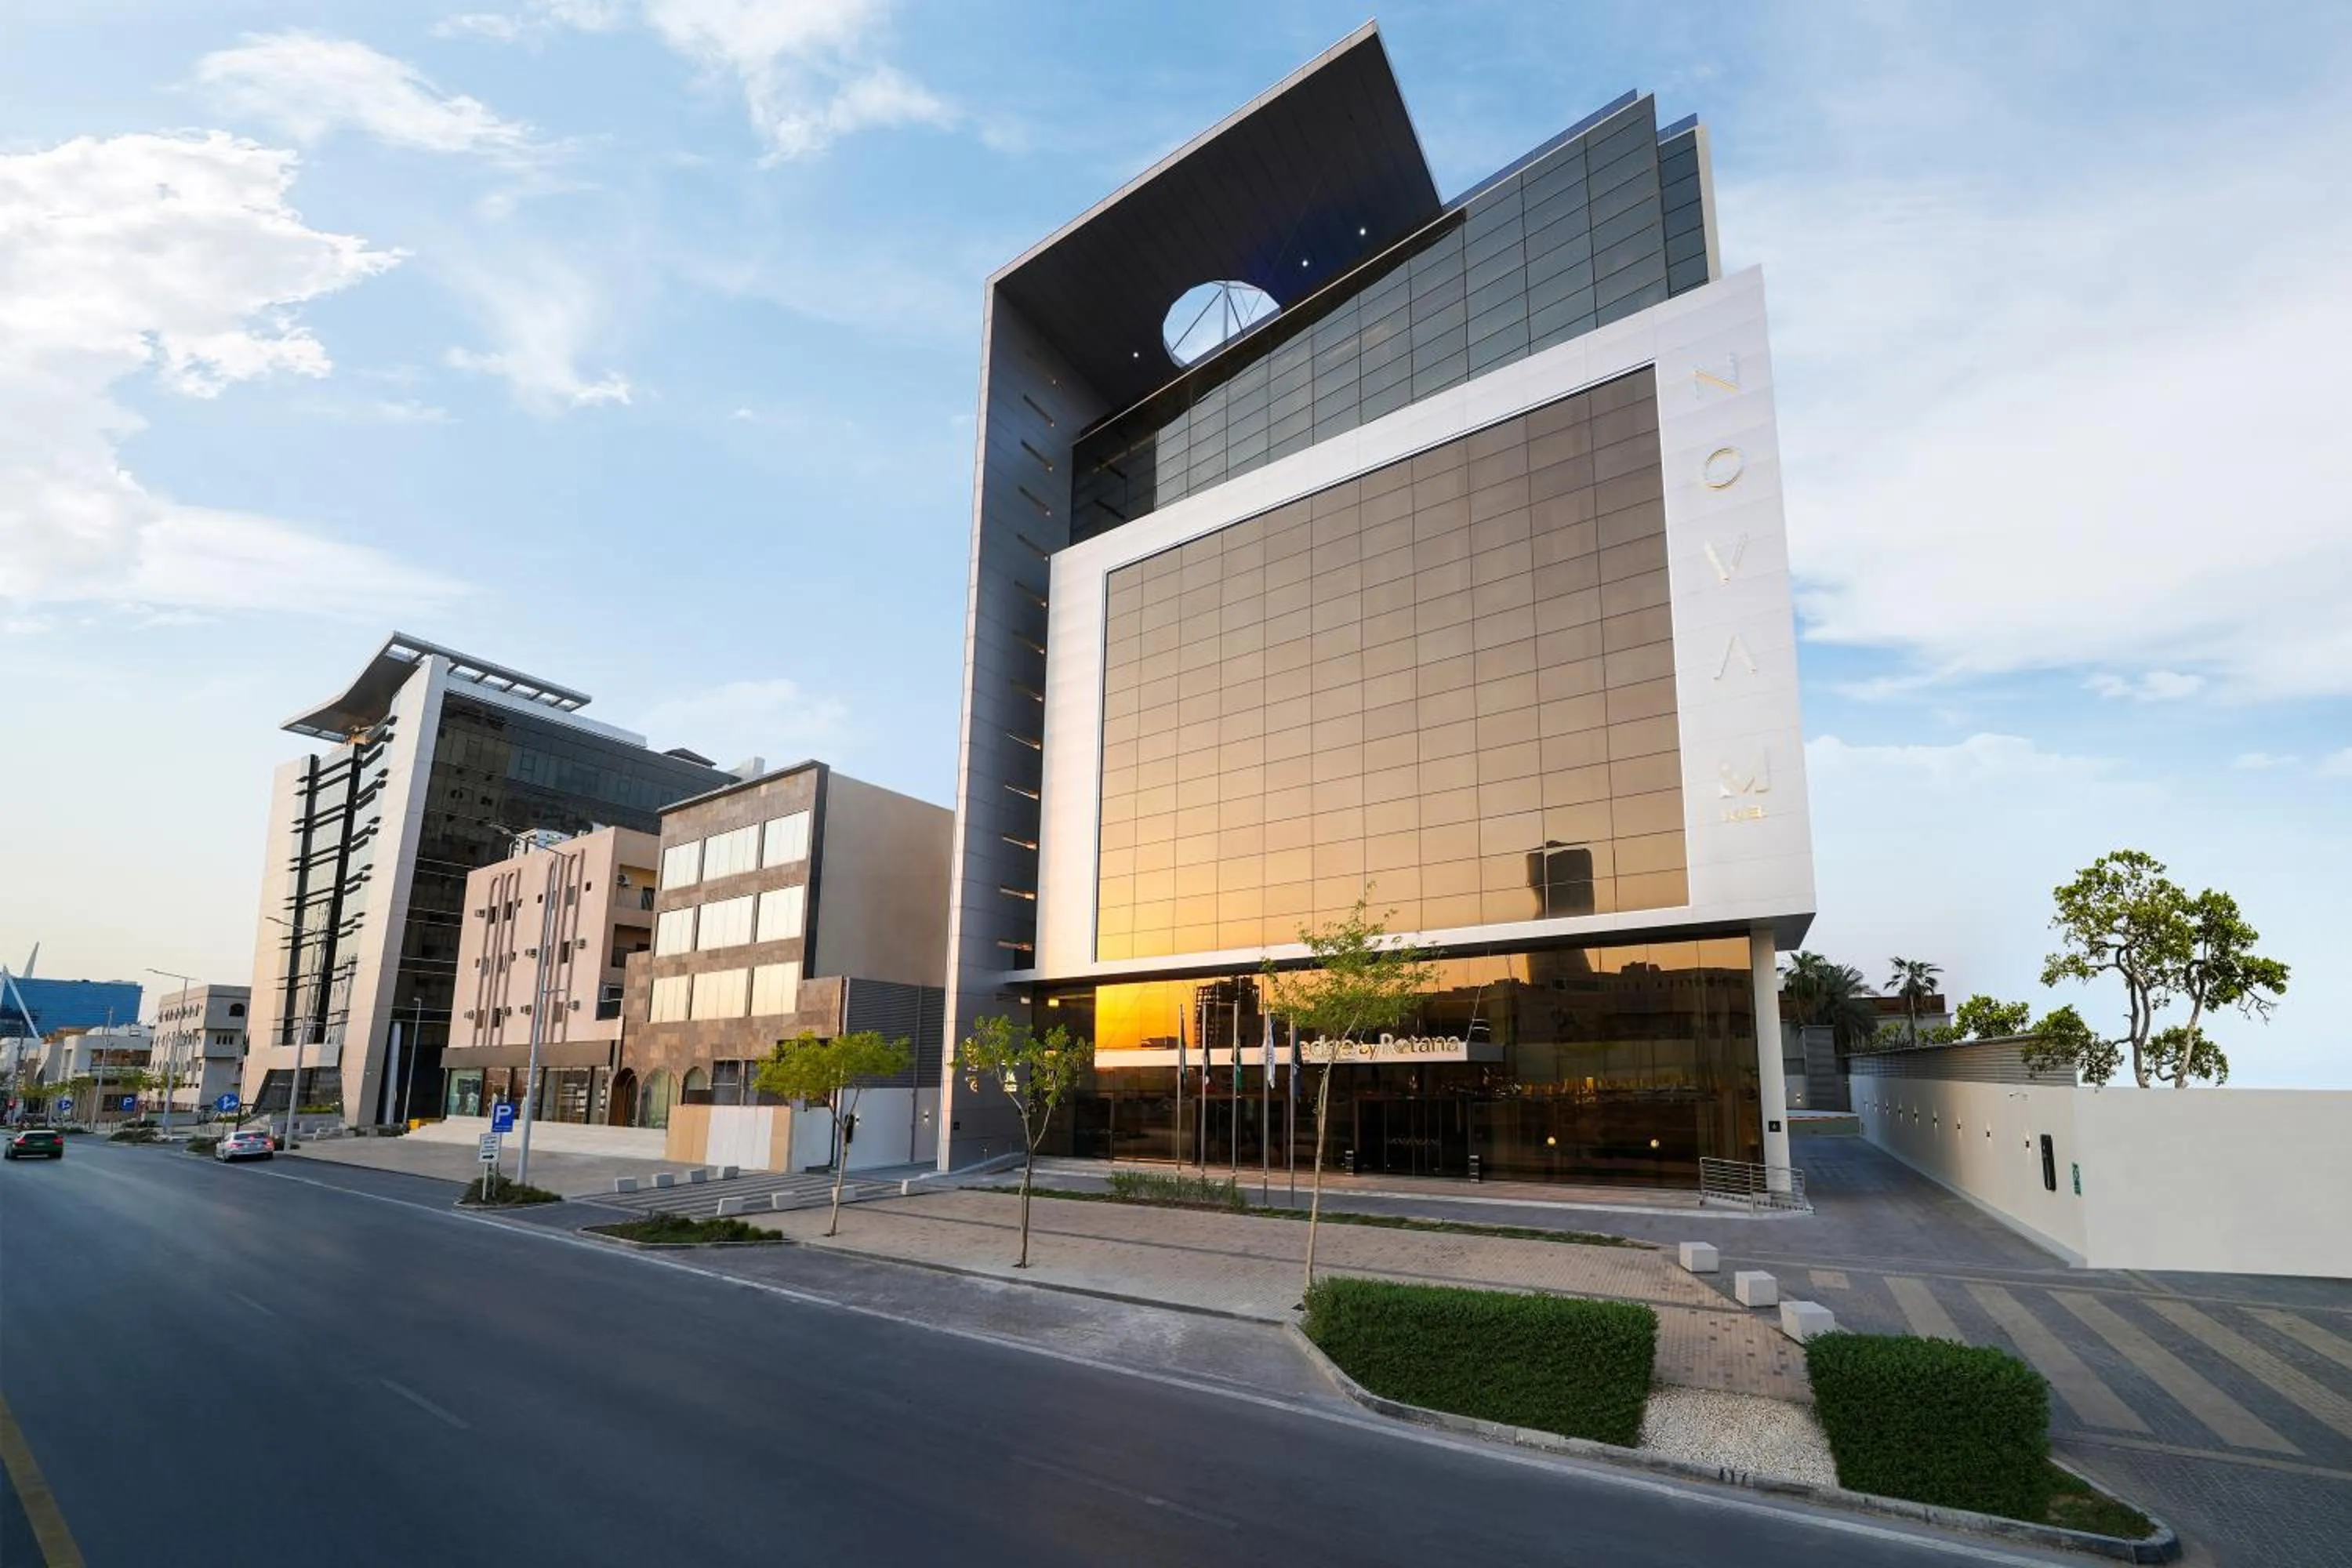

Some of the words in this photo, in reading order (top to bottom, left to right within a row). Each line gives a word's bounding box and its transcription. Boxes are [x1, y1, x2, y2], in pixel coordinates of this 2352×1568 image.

[1358, 1040, 1377, 1060] by
[1380, 1033, 1461, 1054] Rotana
[123, 1098, 133, 1106] P
[495, 1104, 513, 1123] P
